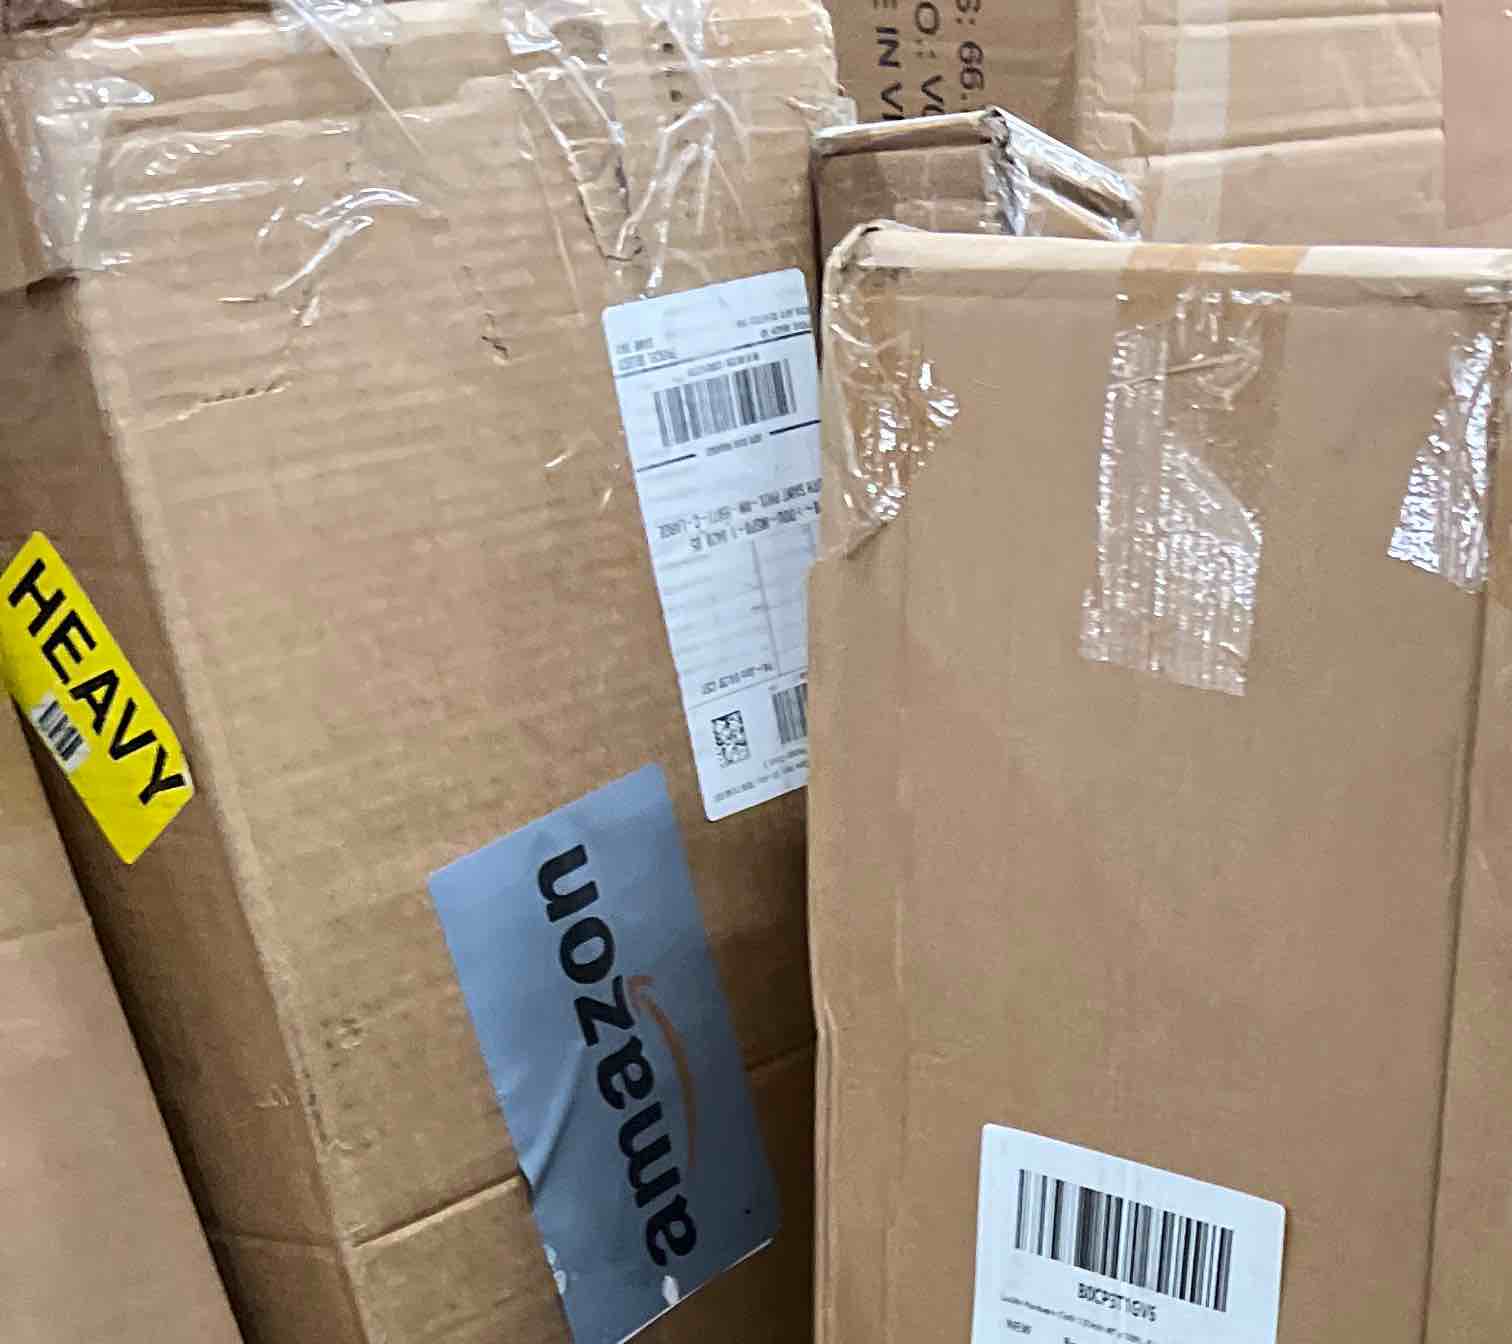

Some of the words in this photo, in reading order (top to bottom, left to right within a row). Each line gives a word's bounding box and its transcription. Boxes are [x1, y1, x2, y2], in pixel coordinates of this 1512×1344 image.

[875, 27, 900, 67] IN
[5, 559, 184, 806] HEAVY
[536, 843, 699, 1267] amazon
